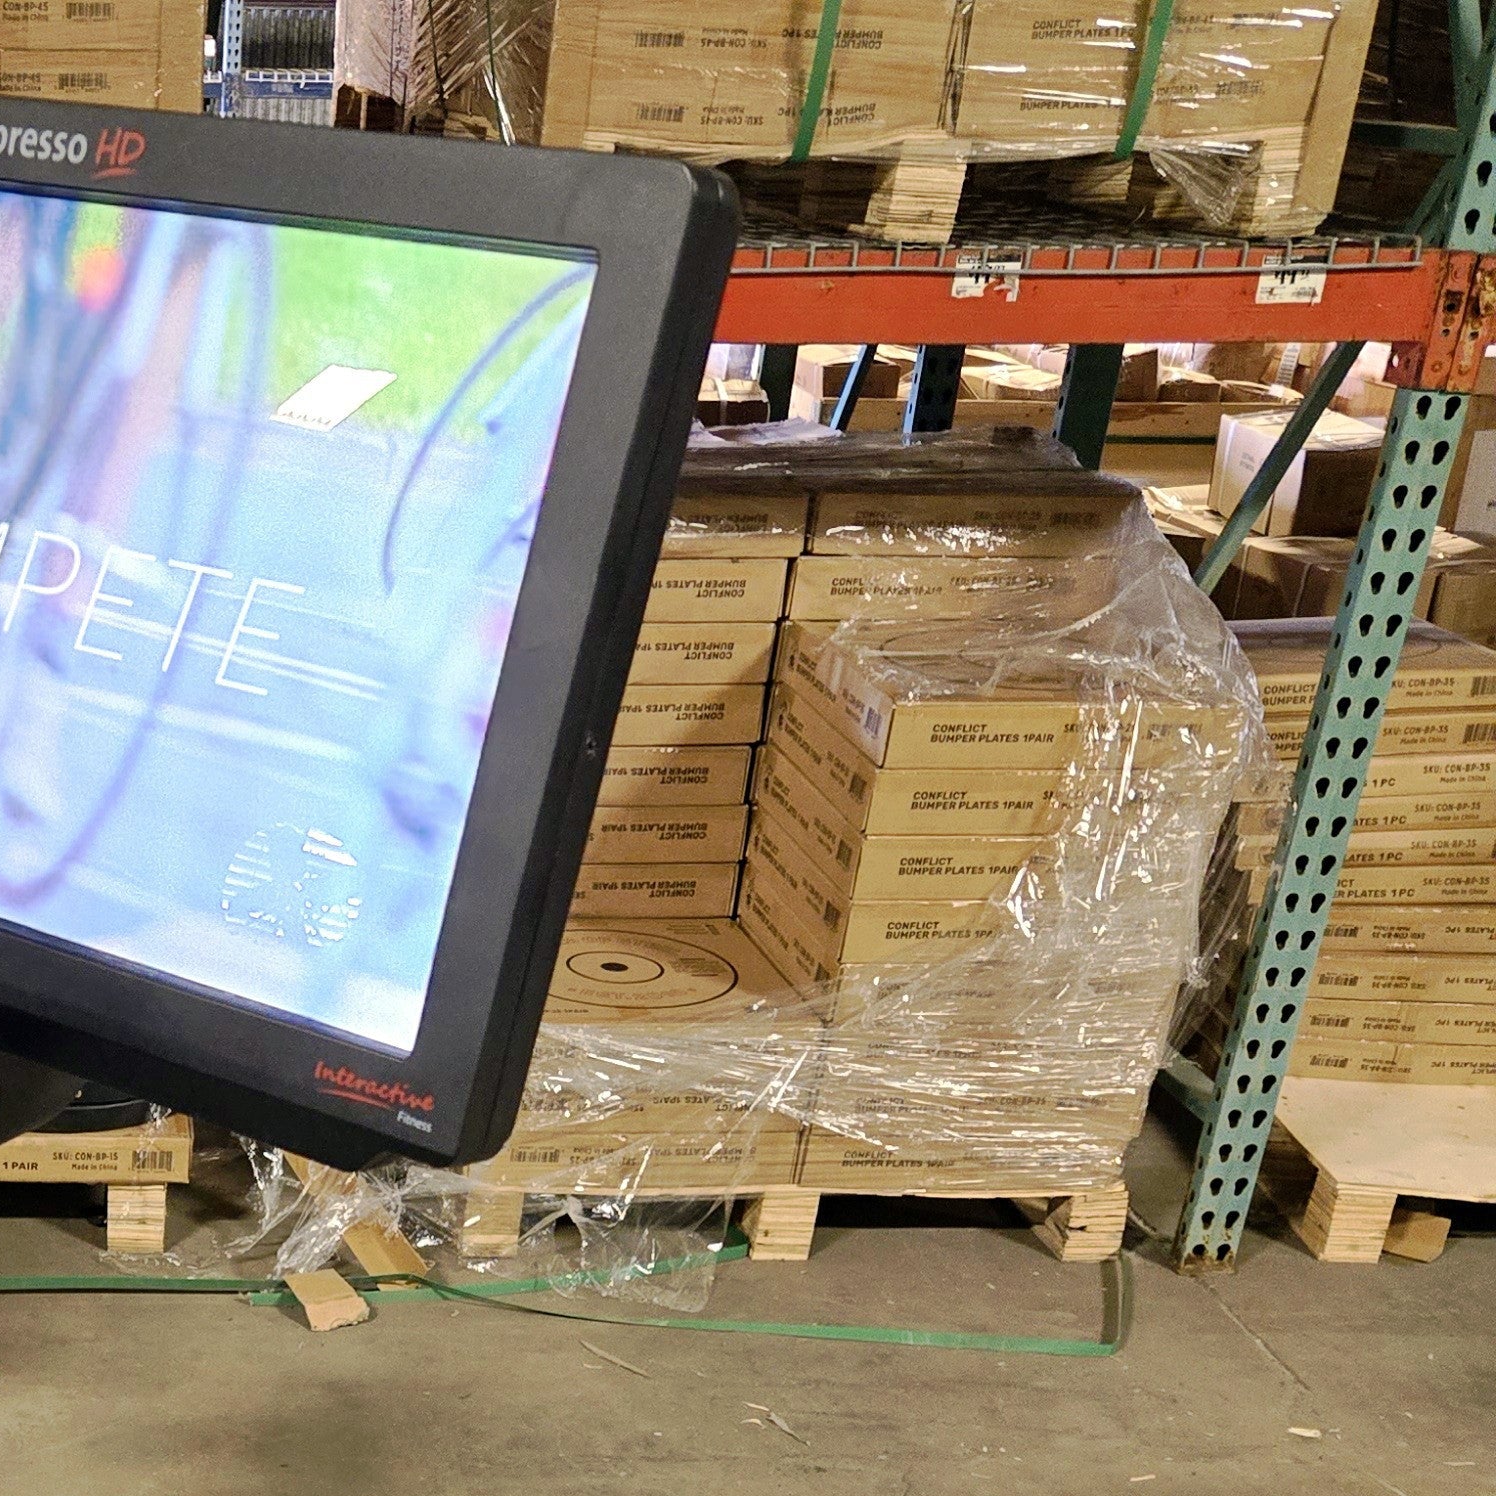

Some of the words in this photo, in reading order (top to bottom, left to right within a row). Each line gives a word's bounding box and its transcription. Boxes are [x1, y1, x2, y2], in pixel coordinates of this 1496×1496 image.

[1032, 19, 1082, 30] CONFLICT
[843, 29, 883, 39] BUMPER
[1031, 29, 1072, 40] BUMPER
[835, 102, 876, 115] BUMPER
[1019, 100, 1059, 111] BUMPER
[745, 115, 764, 126] SKU:
[95, 126, 147, 167] HD
[666, 580, 703, 589] PLATES
[705, 579, 746, 589] BUMPER
[696, 589, 745, 598] CONFLICT
[654, 642, 692, 651] PLATES
[694, 642, 735, 651] BUMPER
[683, 652, 733, 660] CONFLICT
[1264, 683, 1316, 695] CONFLICT
[1262, 695, 1306, 707] BUMPER
[645, 704, 683, 713] PLATES
[684, 702, 725, 712] BUMPER
[675, 712, 724, 721] CONFLICT
[932, 723, 988, 733] CONFLICT
[930, 733, 977, 743] BUMPER
[978, 733, 1020, 743] PLATES
[630, 767, 667, 776] PLATES
[669, 767, 709, 776] BUMPER
[659, 776, 708, 785] CONFLICT
[912, 791, 968, 801] CONFLICT
[910, 801, 958, 811] BUMPER
[958, 801, 1000, 810] PLATES
[630, 823, 666, 832] PLATES
[668, 822, 708, 832] BUMPER
[658, 831, 707, 840] CONFLICT
[899, 857, 953, 866] CONFLICT
[898, 867, 942, 876] BUMPER
[944, 866, 985, 876] PLATES
[621, 881, 657, 890] PLATES
[657, 880, 697, 889] BUMPER
[648, 889, 696, 898] CONFLICT
[1346, 889, 1387, 899] PLATES
[887, 921, 940, 930] CONFLICT
[885, 930, 929, 940] BUMPER
[931, 930, 971, 939] PLATES
[53, 1151, 73, 1161] SKU:
[843, 1151, 893, 1159] CONFLICT
[71, 1163, 90, 1171] Made
[99, 1163, 118, 1171] China
